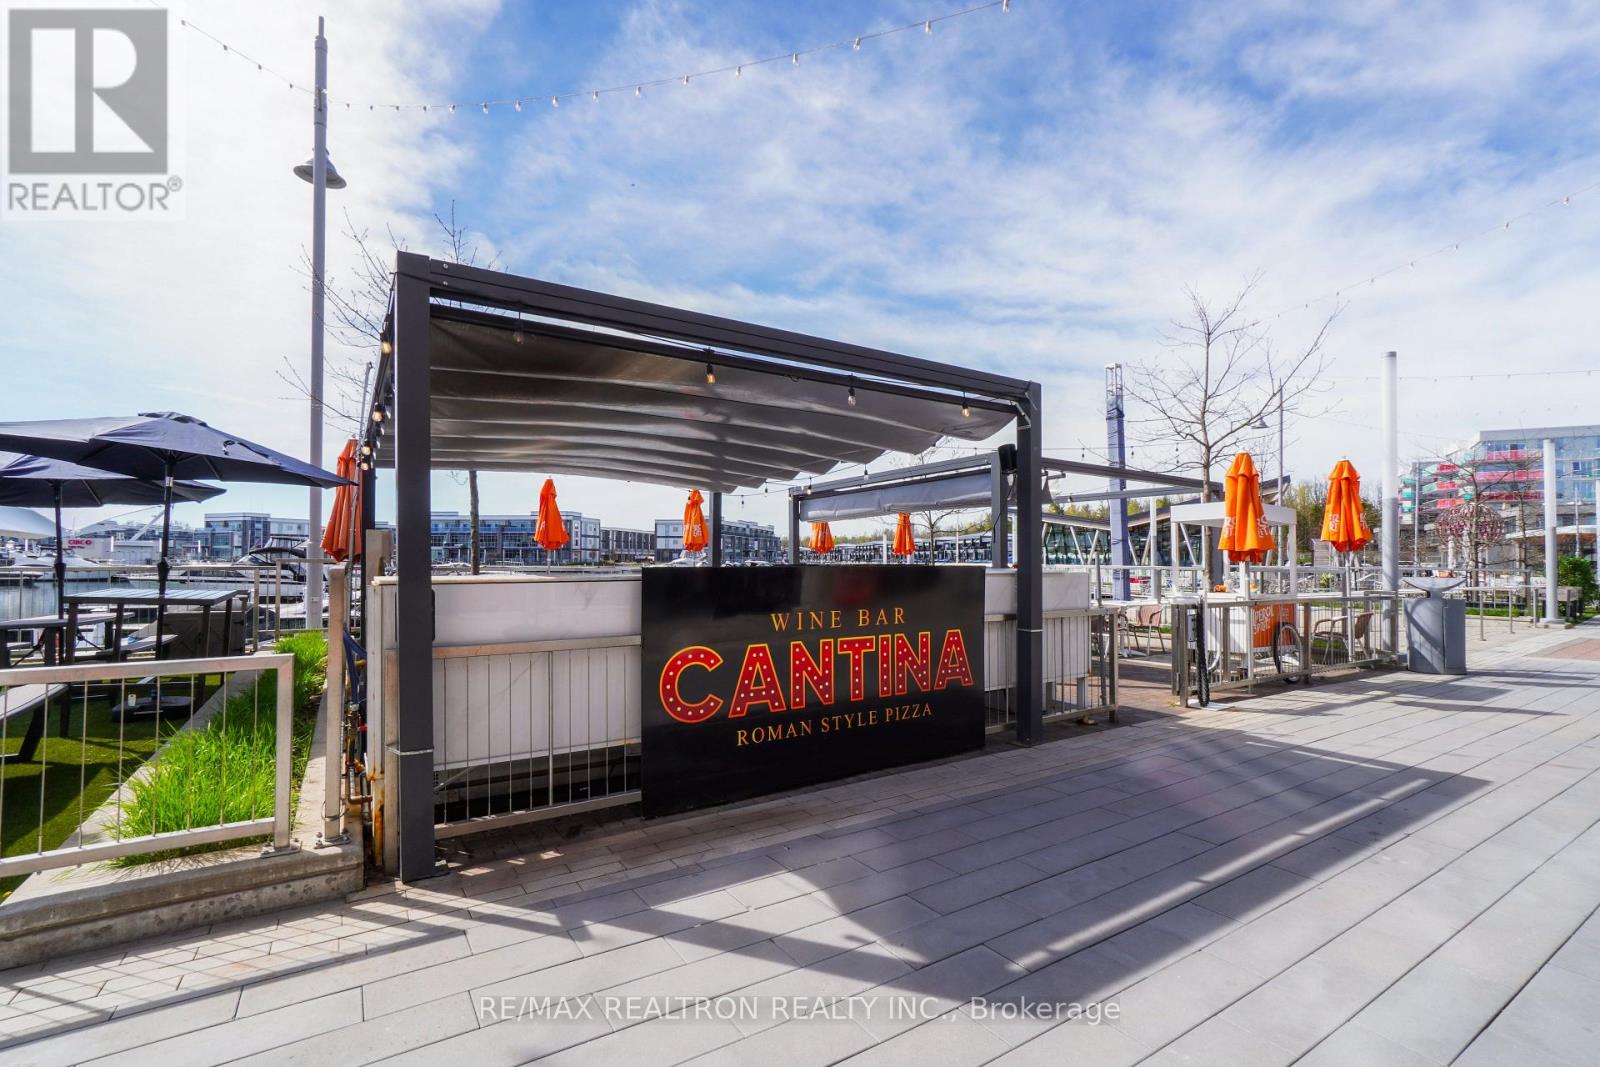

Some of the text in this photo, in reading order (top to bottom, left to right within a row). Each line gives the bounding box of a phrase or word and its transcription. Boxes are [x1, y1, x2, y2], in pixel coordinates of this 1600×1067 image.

[771, 607, 905, 632] WINE BAR
[659, 629, 974, 724] CANTINA
[736, 703, 933, 747] ROMAN STYLE PIZZA
